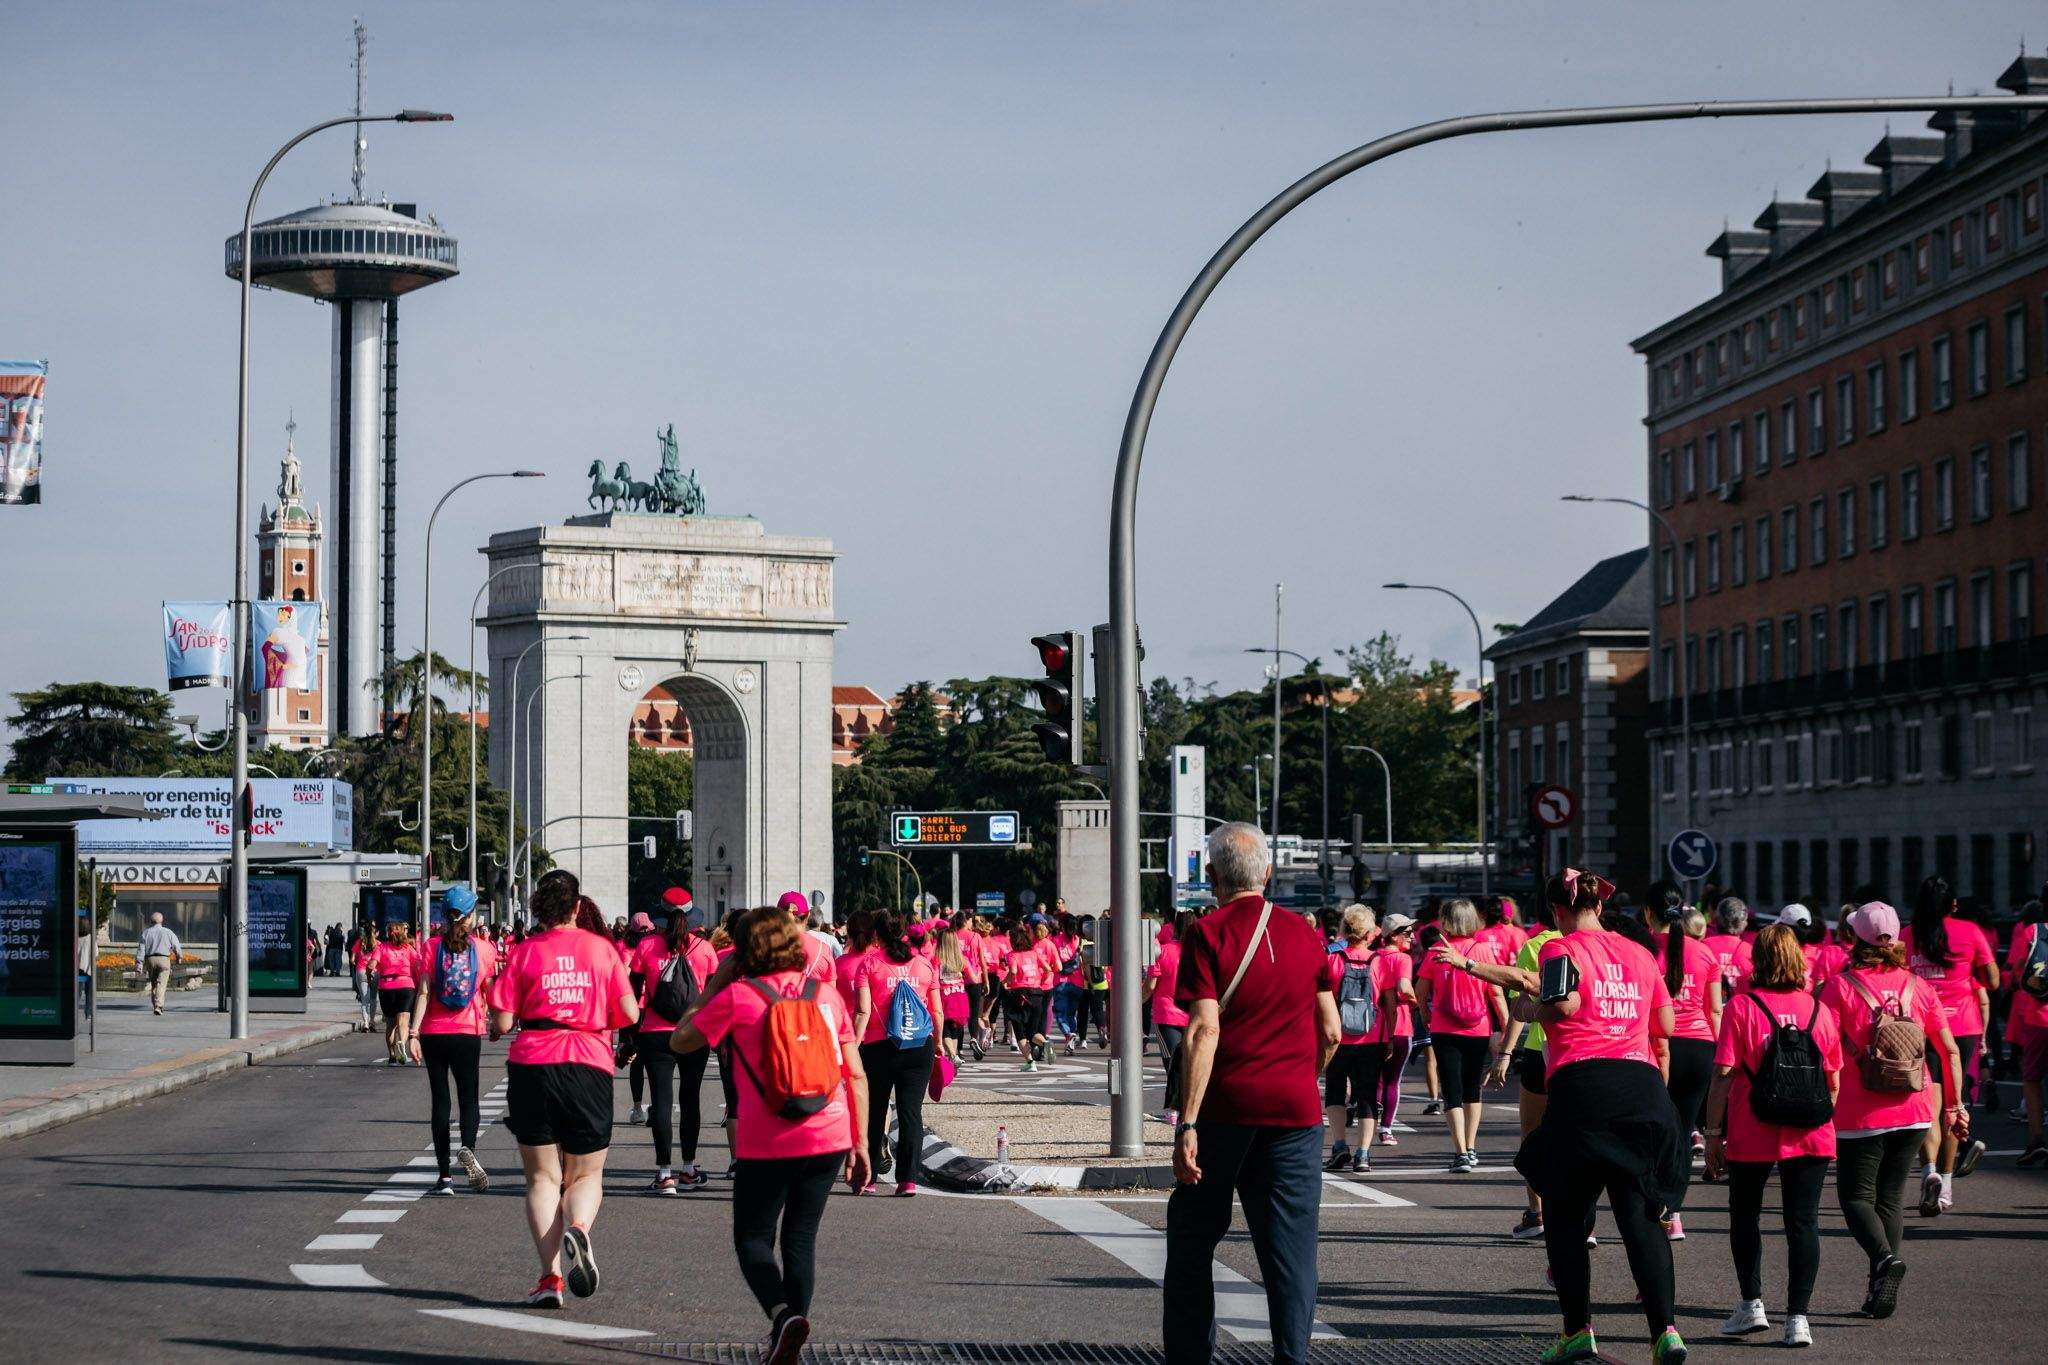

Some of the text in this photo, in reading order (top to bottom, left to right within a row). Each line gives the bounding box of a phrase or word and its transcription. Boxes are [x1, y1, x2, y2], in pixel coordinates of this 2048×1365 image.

[169, 618, 197, 637] SAN
[166, 787, 235, 806] enemig
[180, 804, 201, 818] de
[205, 805, 223, 819] tu
[921, 816, 955, 824] CARRIL
[921, 825, 945, 833] SOLO
[921, 833, 962, 842] ABIERTO
[103, 866, 219, 882] MONCLOA
[32, 934, 40, 947] y
[0, 947, 50, 960] vables
[556, 955, 575, 971] TU
[1604, 963, 1624, 981] TU
[541, 971, 591, 990] DORSAL
[548, 988, 585, 1006] SUMA
[1594, 980, 1642, 1000] DORSAL
[1600, 1000, 1638, 1020] SUMA
